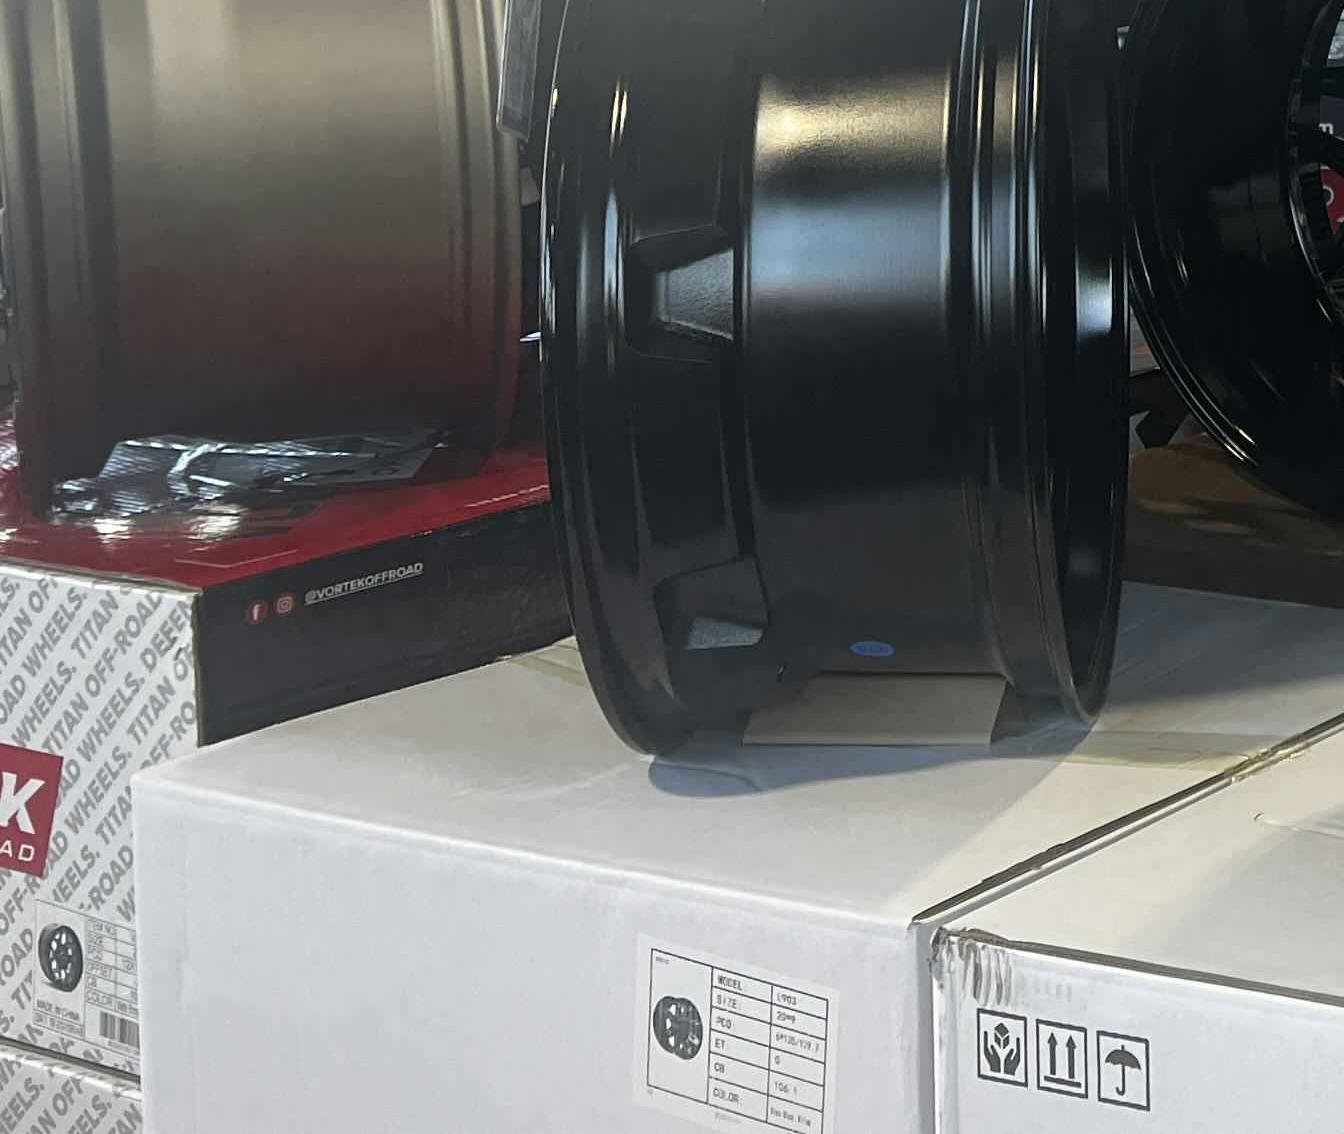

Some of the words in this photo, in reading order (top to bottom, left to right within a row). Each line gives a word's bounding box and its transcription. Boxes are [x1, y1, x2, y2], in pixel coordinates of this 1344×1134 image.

[304, 562, 424, 606] @VORTEKOFFROAD
[11, 661, 77, 747] WHEELS.
[70, 590, 119, 660] TITAN
[21, 587, 88, 678] WHEELS.
[42, 692, 89, 754] TITAN
[64, 746, 133, 835] WHEELS.
[126, 676, 176, 745] TITAN
[77, 671, 145, 762] WHEELS.
